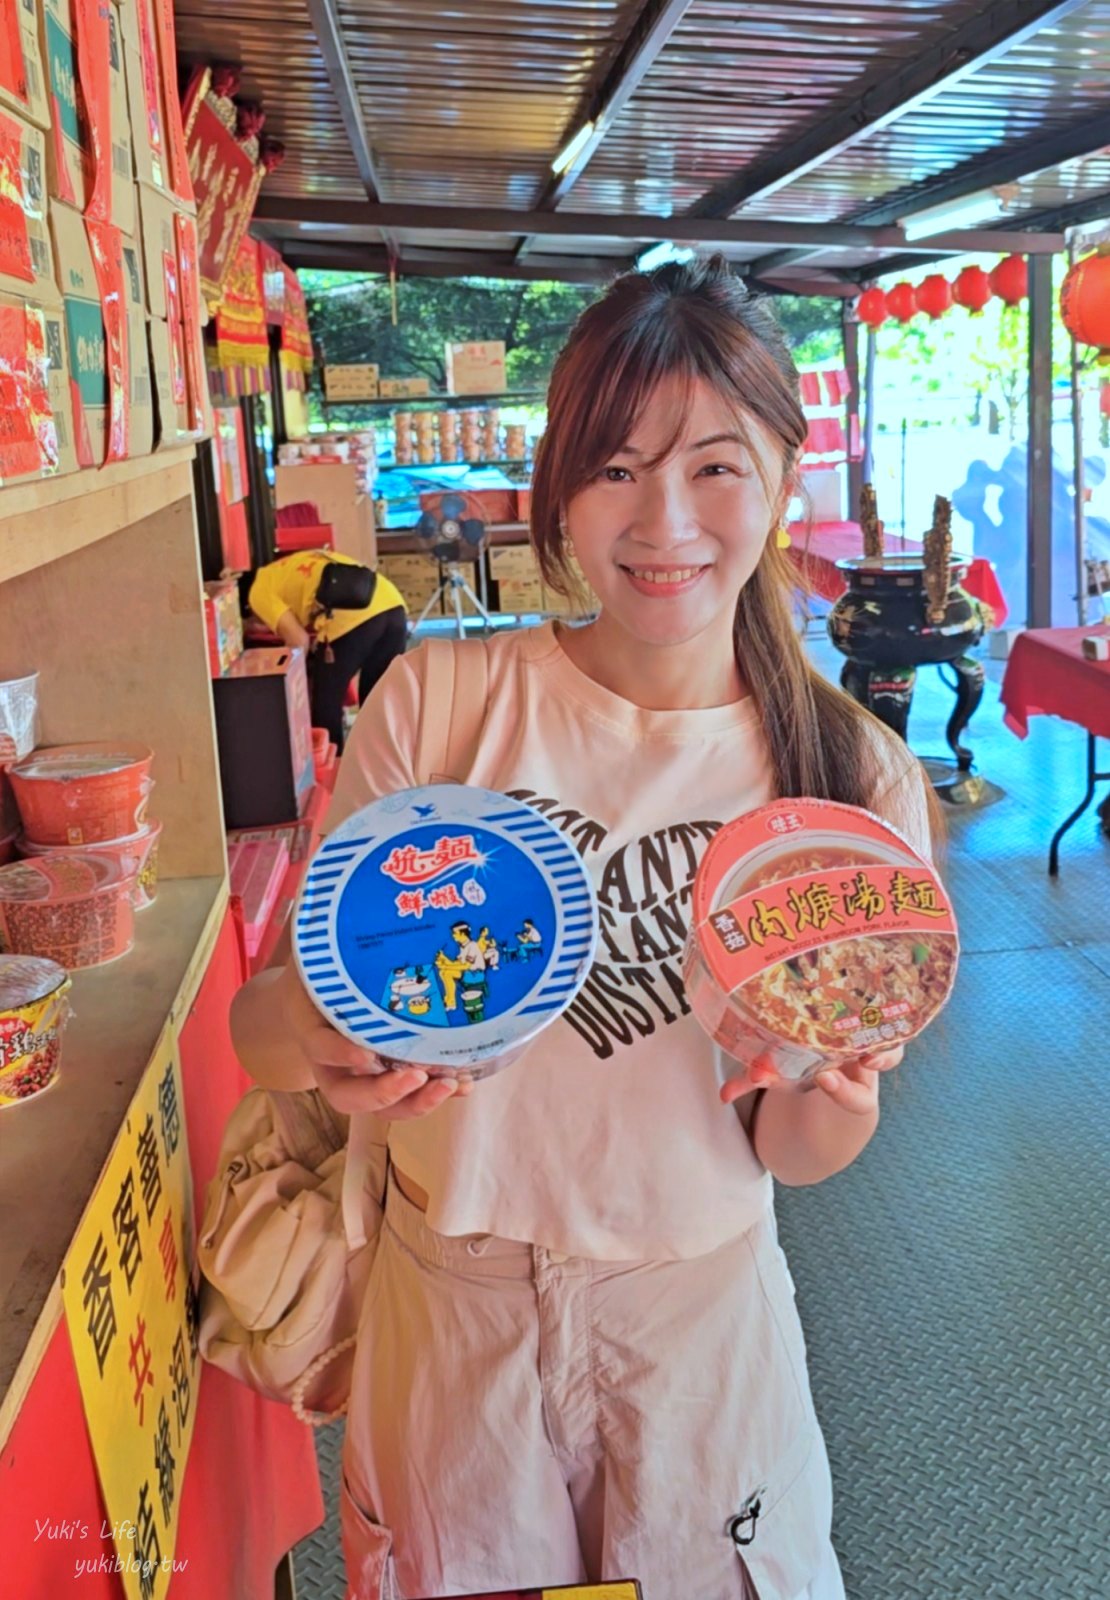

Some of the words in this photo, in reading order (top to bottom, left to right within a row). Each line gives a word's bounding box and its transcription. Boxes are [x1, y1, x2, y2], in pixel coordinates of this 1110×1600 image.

[381, 836, 478, 880] 統一麵
[714, 913, 747, 951] 香菇
